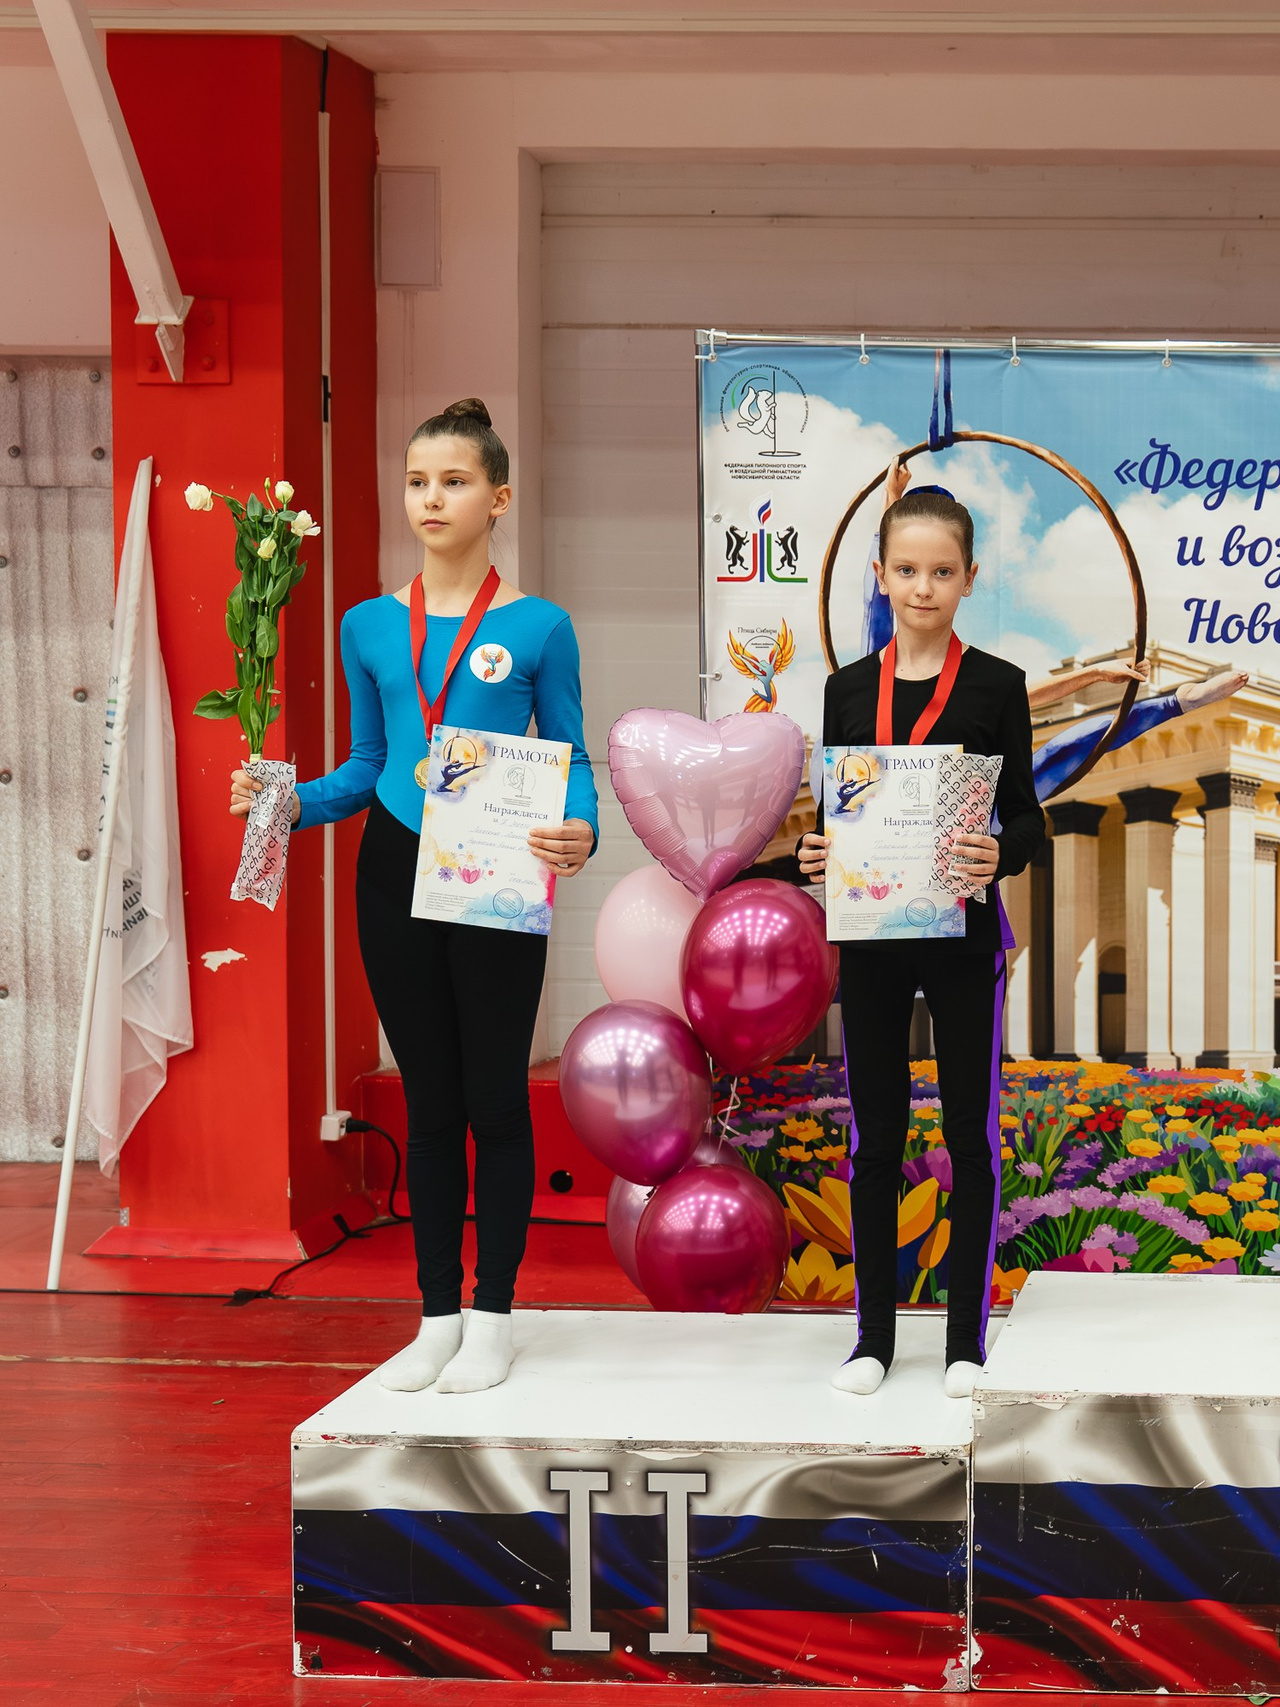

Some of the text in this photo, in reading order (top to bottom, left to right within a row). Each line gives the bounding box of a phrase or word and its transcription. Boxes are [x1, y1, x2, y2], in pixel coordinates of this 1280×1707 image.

[1177, 537, 1204, 568] и
[491, 745, 560, 766] ГРАМОТА
[884, 758, 936, 770] ГРАМО
[484, 803, 549, 820] Награждается
[550, 1471, 707, 1652] II
